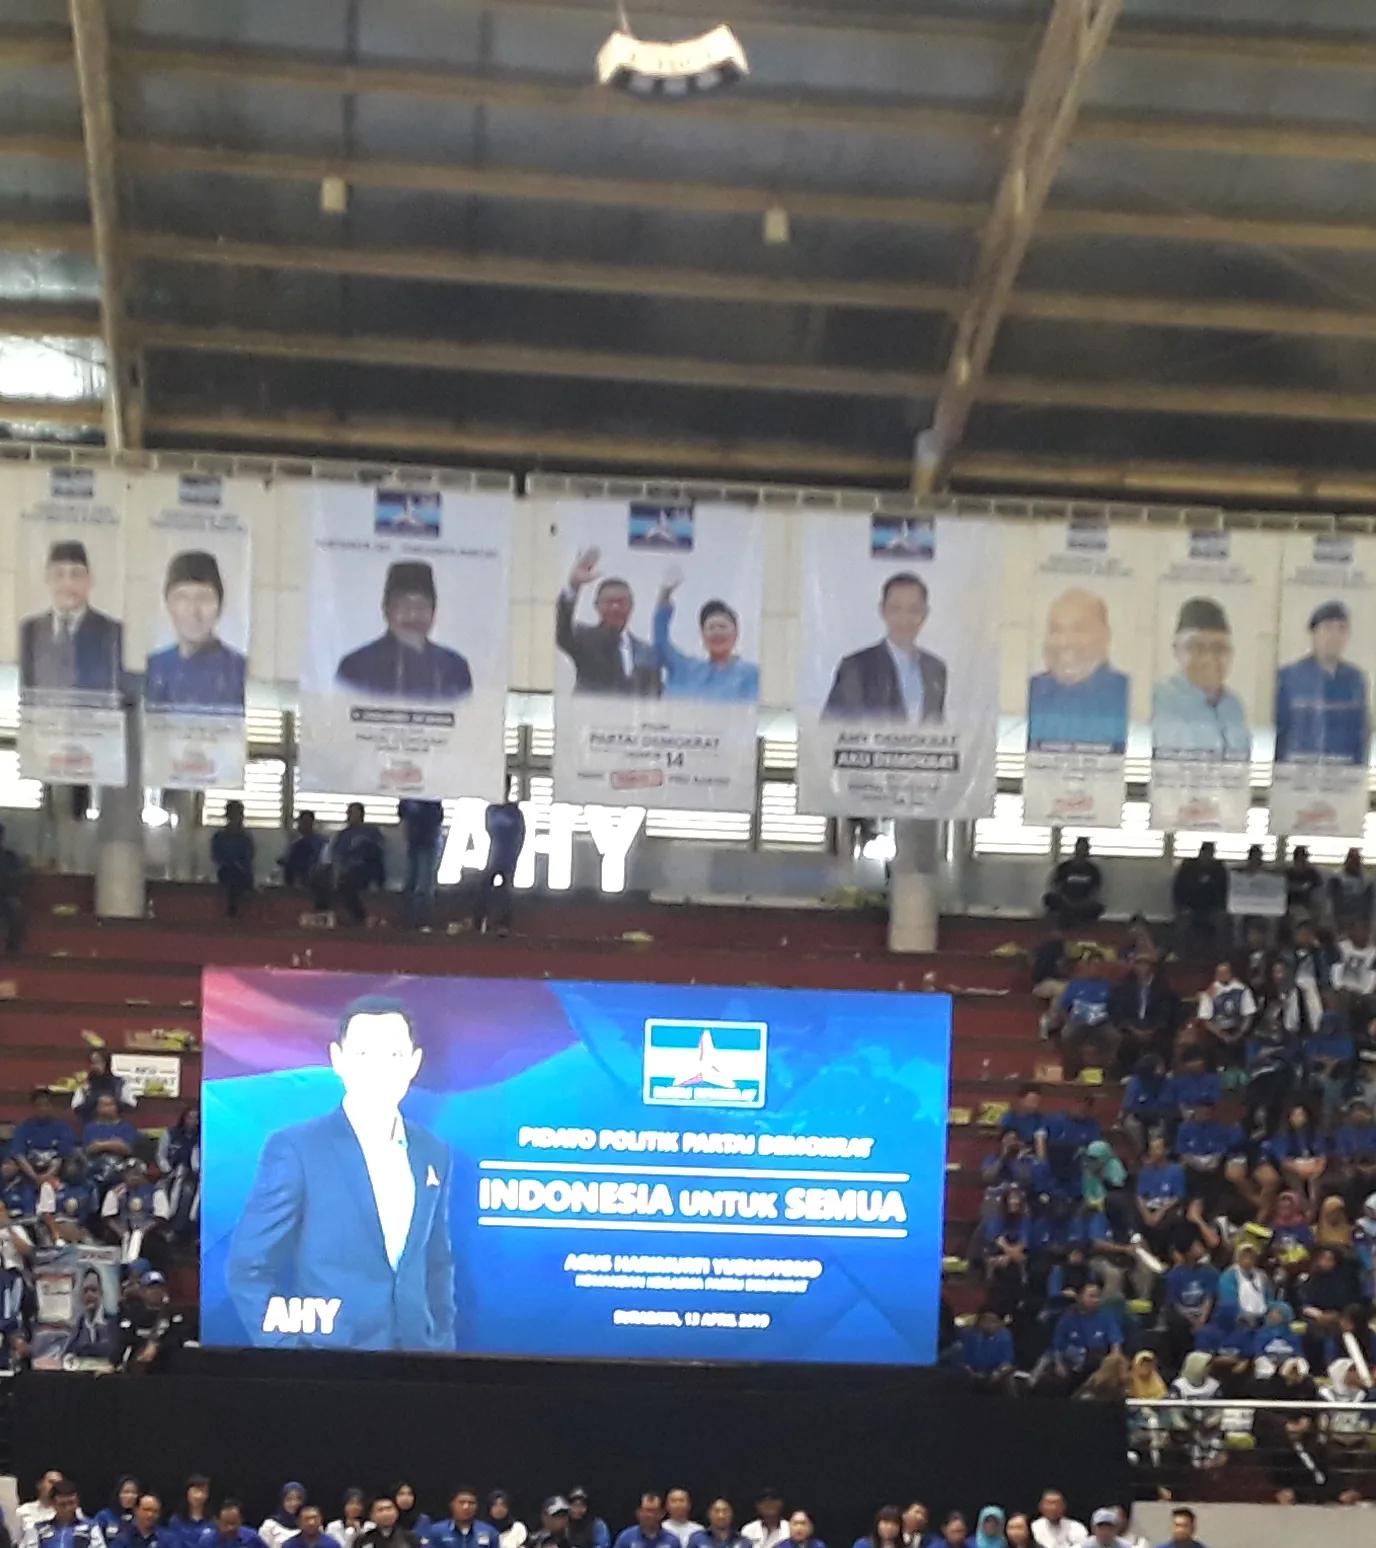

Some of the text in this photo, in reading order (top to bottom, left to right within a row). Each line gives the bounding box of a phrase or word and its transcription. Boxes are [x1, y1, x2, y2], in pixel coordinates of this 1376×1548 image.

[518, 1126, 875, 1159] PIDATO POLITIK PARTAI DEMOKRAT
[478, 1177, 909, 1222] INDONESIA UNTUK SEMUA
[261, 1297, 342, 1334] AHY
